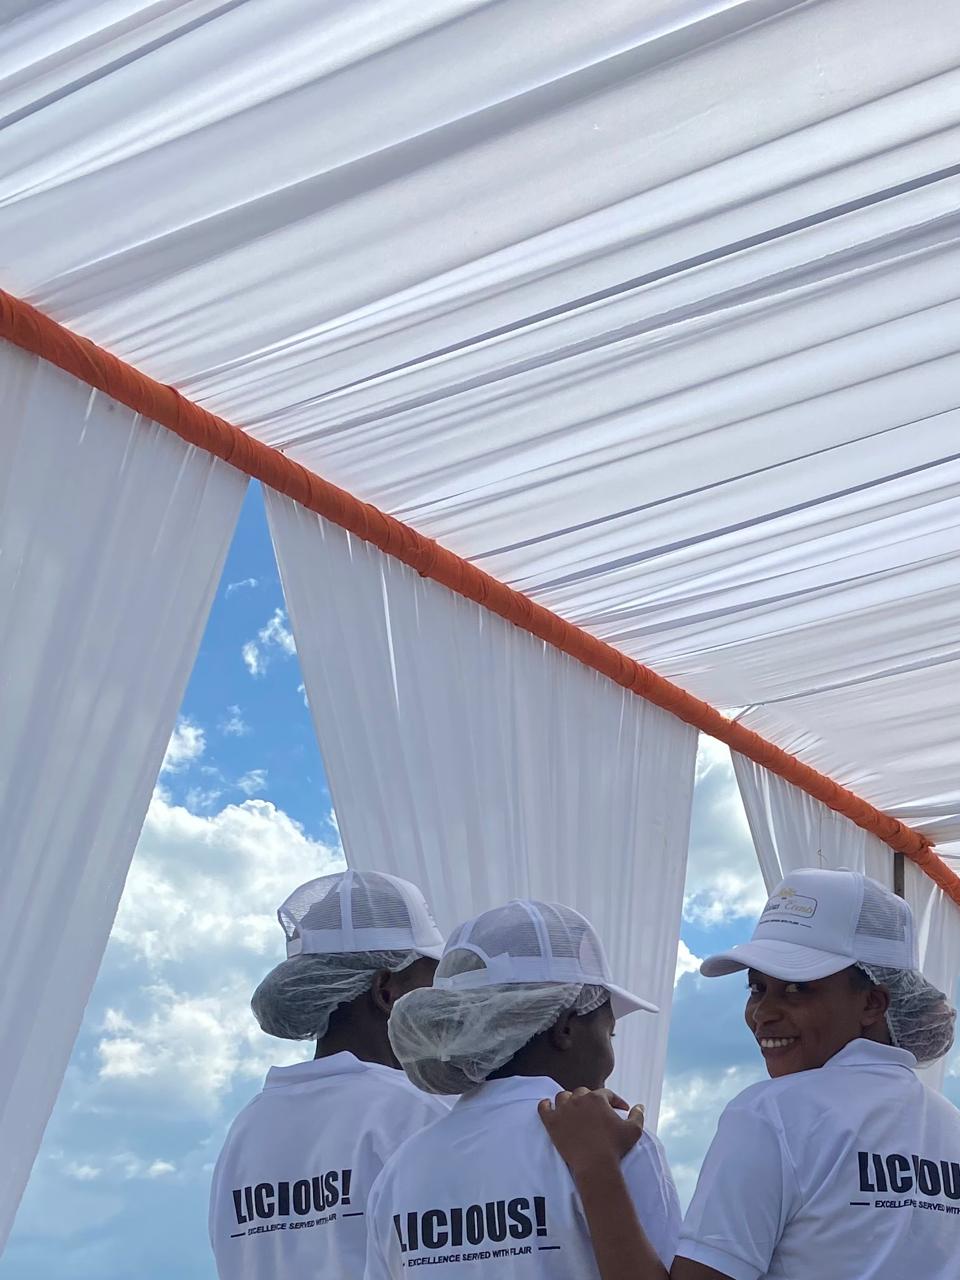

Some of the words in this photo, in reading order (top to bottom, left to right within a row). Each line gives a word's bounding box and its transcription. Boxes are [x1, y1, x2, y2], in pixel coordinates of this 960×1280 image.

[232, 1169, 352, 1225] LICIOUS!
[874, 1198, 918, 1209] EXCELLENE
[288, 1219, 316, 1230] SERVED
[393, 1196, 548, 1253] LICIOUS!
[408, 1254, 461, 1268] EXCELLENCE
[492, 1247, 510, 1259] WITH
[509, 1245, 533, 1256] FLAIR
